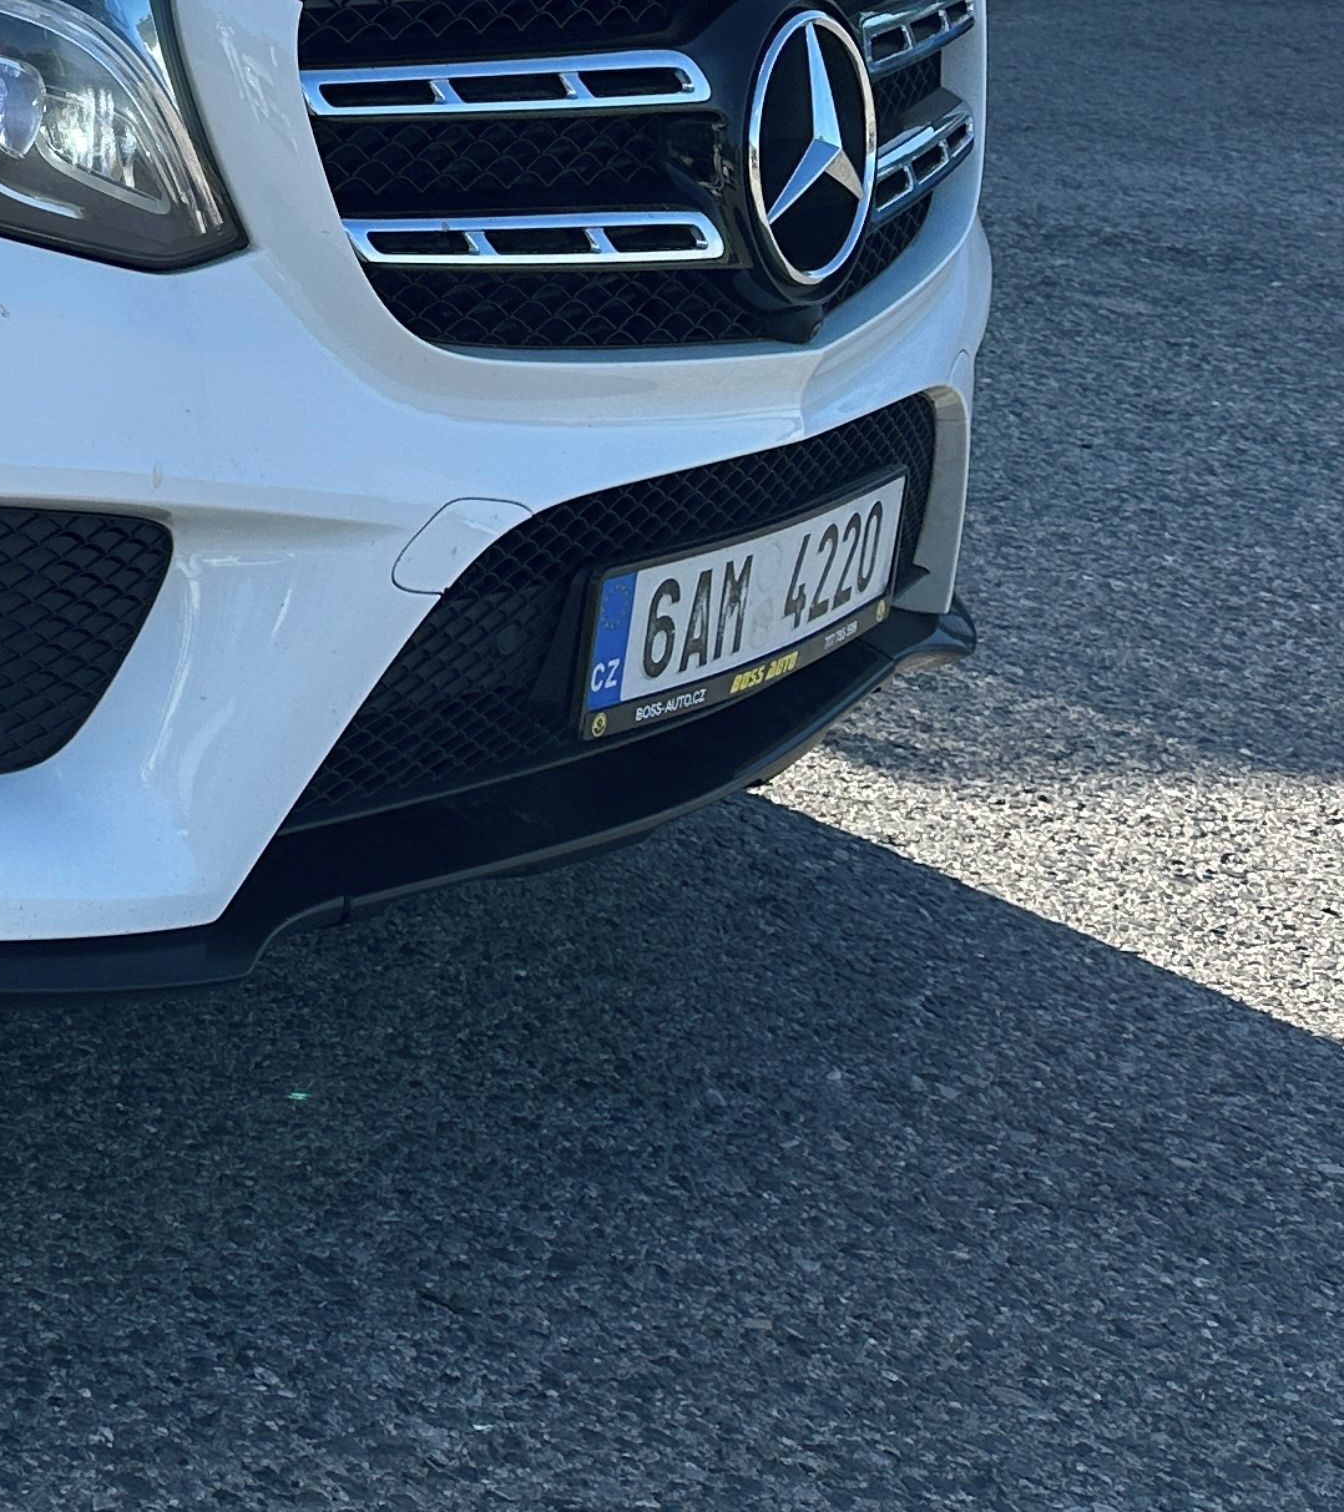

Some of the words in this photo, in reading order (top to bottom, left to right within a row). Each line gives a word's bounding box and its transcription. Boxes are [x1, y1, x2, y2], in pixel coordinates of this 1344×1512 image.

[642, 554, 755, 681] 6AM
[780, 500, 884, 630] 4220
[590, 657, 621, 693] CZ
[730, 666, 766, 694] BOSS
[765, 650, 799, 681] AUTO
[635, 688, 707, 722] BOSS-AUTO.CZ
